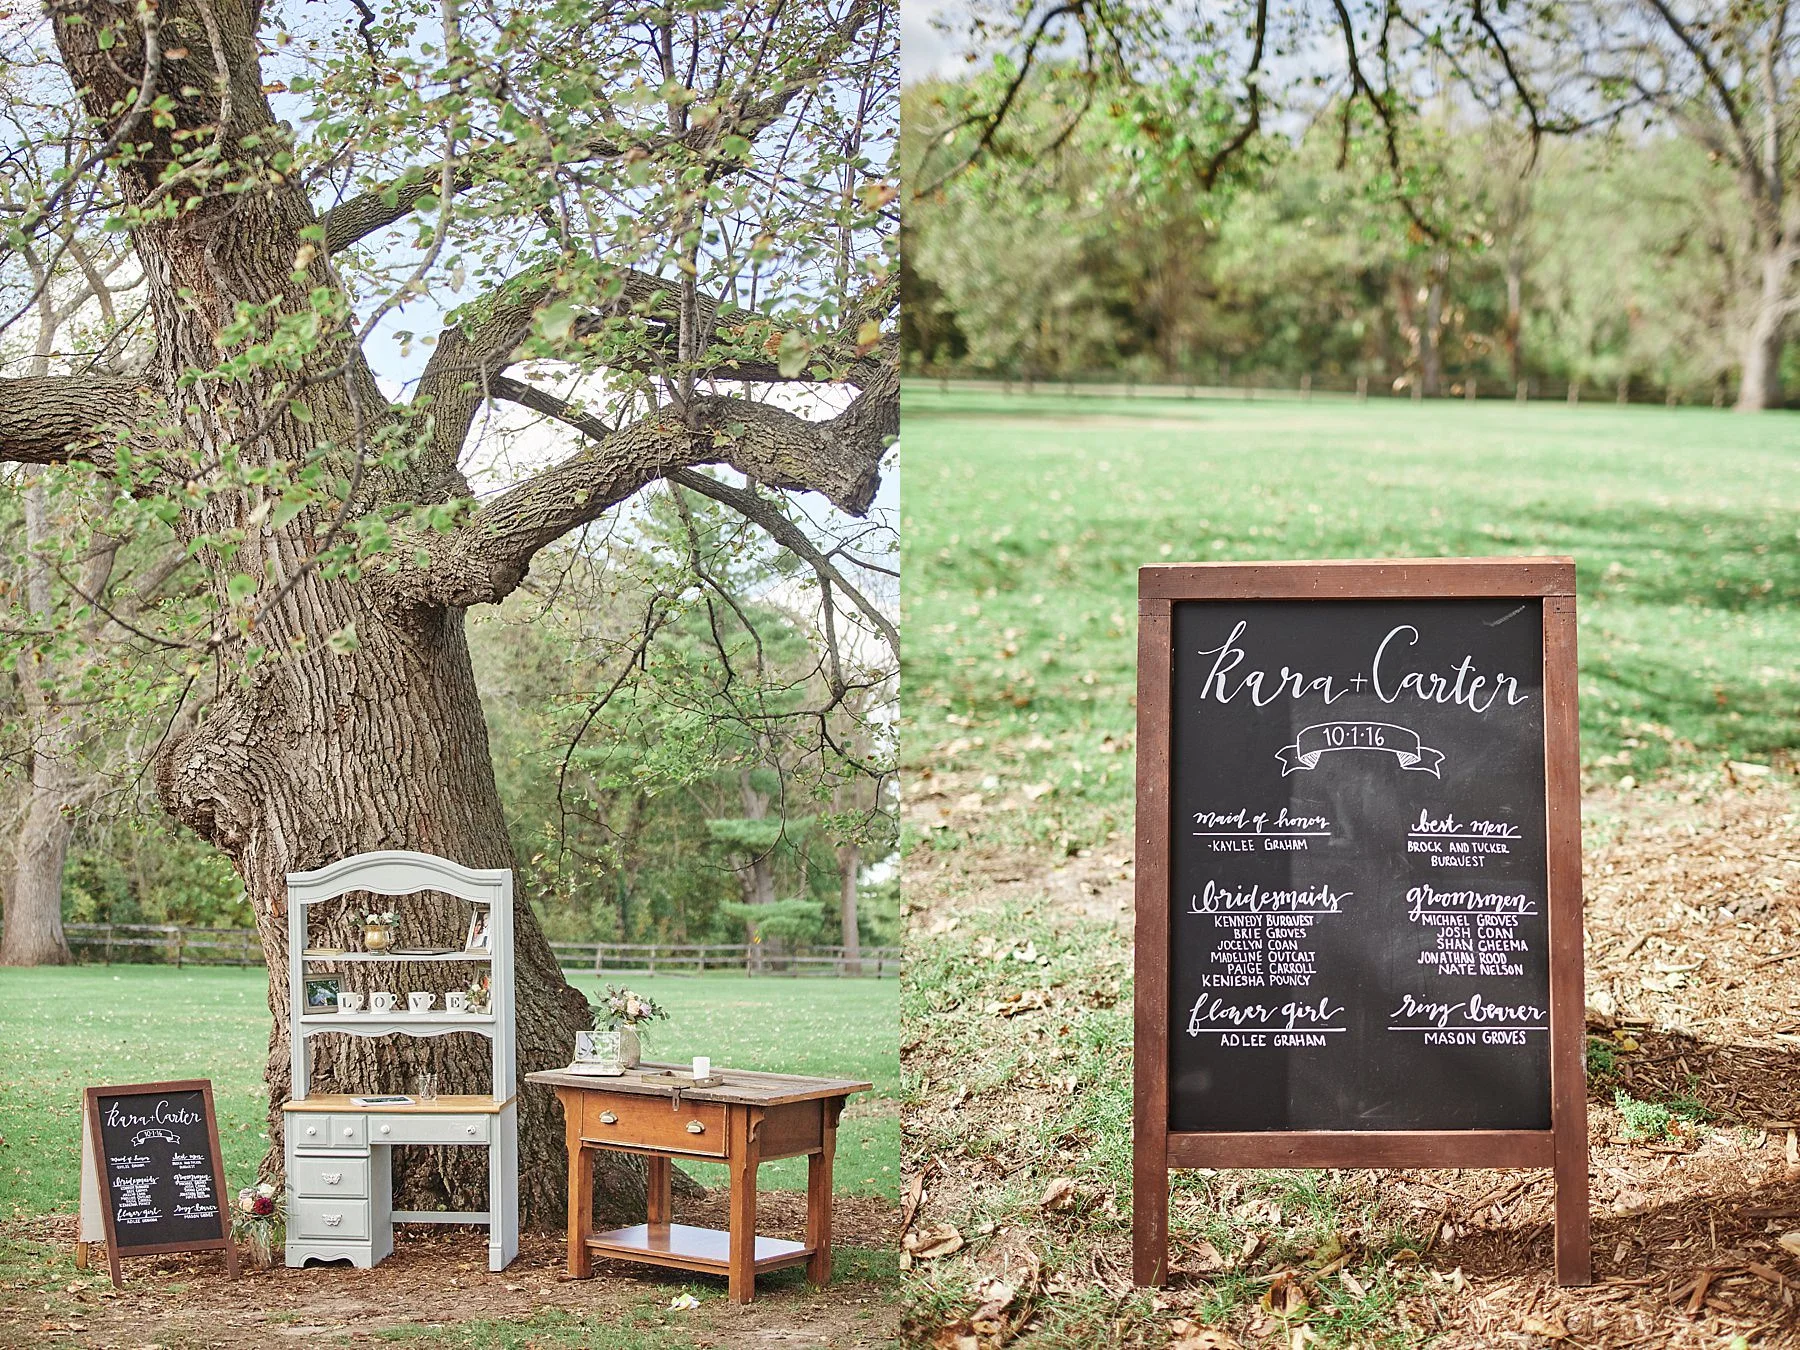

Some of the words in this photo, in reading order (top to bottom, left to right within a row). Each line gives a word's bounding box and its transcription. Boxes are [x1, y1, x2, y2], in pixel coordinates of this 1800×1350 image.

[1371, 624, 1529, 713] Carter
[1192, 808, 1250, 829] maid
[1252, 812, 1270, 834] of
[1273, 807, 1331, 830] honor
[1411, 808, 1463, 834] best
[1469, 820, 1519, 837] men
[1264, 838, 1309, 851] GRAHAM
[1407, 840, 1443, 853] BROCK
[1449, 842, 1470, 853] AND
[1471, 843, 1510, 854] TUCKER
[1431, 855, 1486, 868] BURQUEST
[1191, 879, 1354, 913] bridesmaids
[1405, 883, 1536, 922] groomsmen
[1214, 915, 1263, 928] KENNEDY
[1266, 915, 1314, 927] BURQUEST
[1421, 914, 1471, 927] MICHAEL
[1476, 914, 1519, 927] GROVES
[1233, 928, 1262, 940] BRIE
[1265, 927, 1307, 939] GROVES
[1436, 927, 1471, 939] JOSH
[1477, 927, 1514, 940] COAN
[1217, 940, 1263, 951] JOCELYN
[1267, 939, 1299, 951] COAN
[1436, 937, 1474, 951] SHAN
[1210, 951, 1263, 963] MADELINE
[1267, 951, 1316, 963] OUTCALT
[1417, 951, 1475, 965] JONATHAN
[1479, 952, 1508, 965] ROOD
[1227, 963, 1264, 975] PAIGE
[1269, 962, 1317, 975] CARROLL
[1438, 963, 1478, 976] NATE
[1480, 963, 1524, 976] NELSON
[1201, 974, 1266, 988] KENIESHA
[1269, 974, 1312, 987] POUNCY
[1188, 992, 1279, 1037] flower
[1281, 997, 1345, 1031] girl
[1389, 993, 1466, 1029] ring
[1463, 993, 1547, 1022] bearer
[1273, 1033, 1327, 1047] GRAHAM
[1424, 1031, 1476, 1046] MASON
[1482, 1030, 1527, 1046] GROVES
